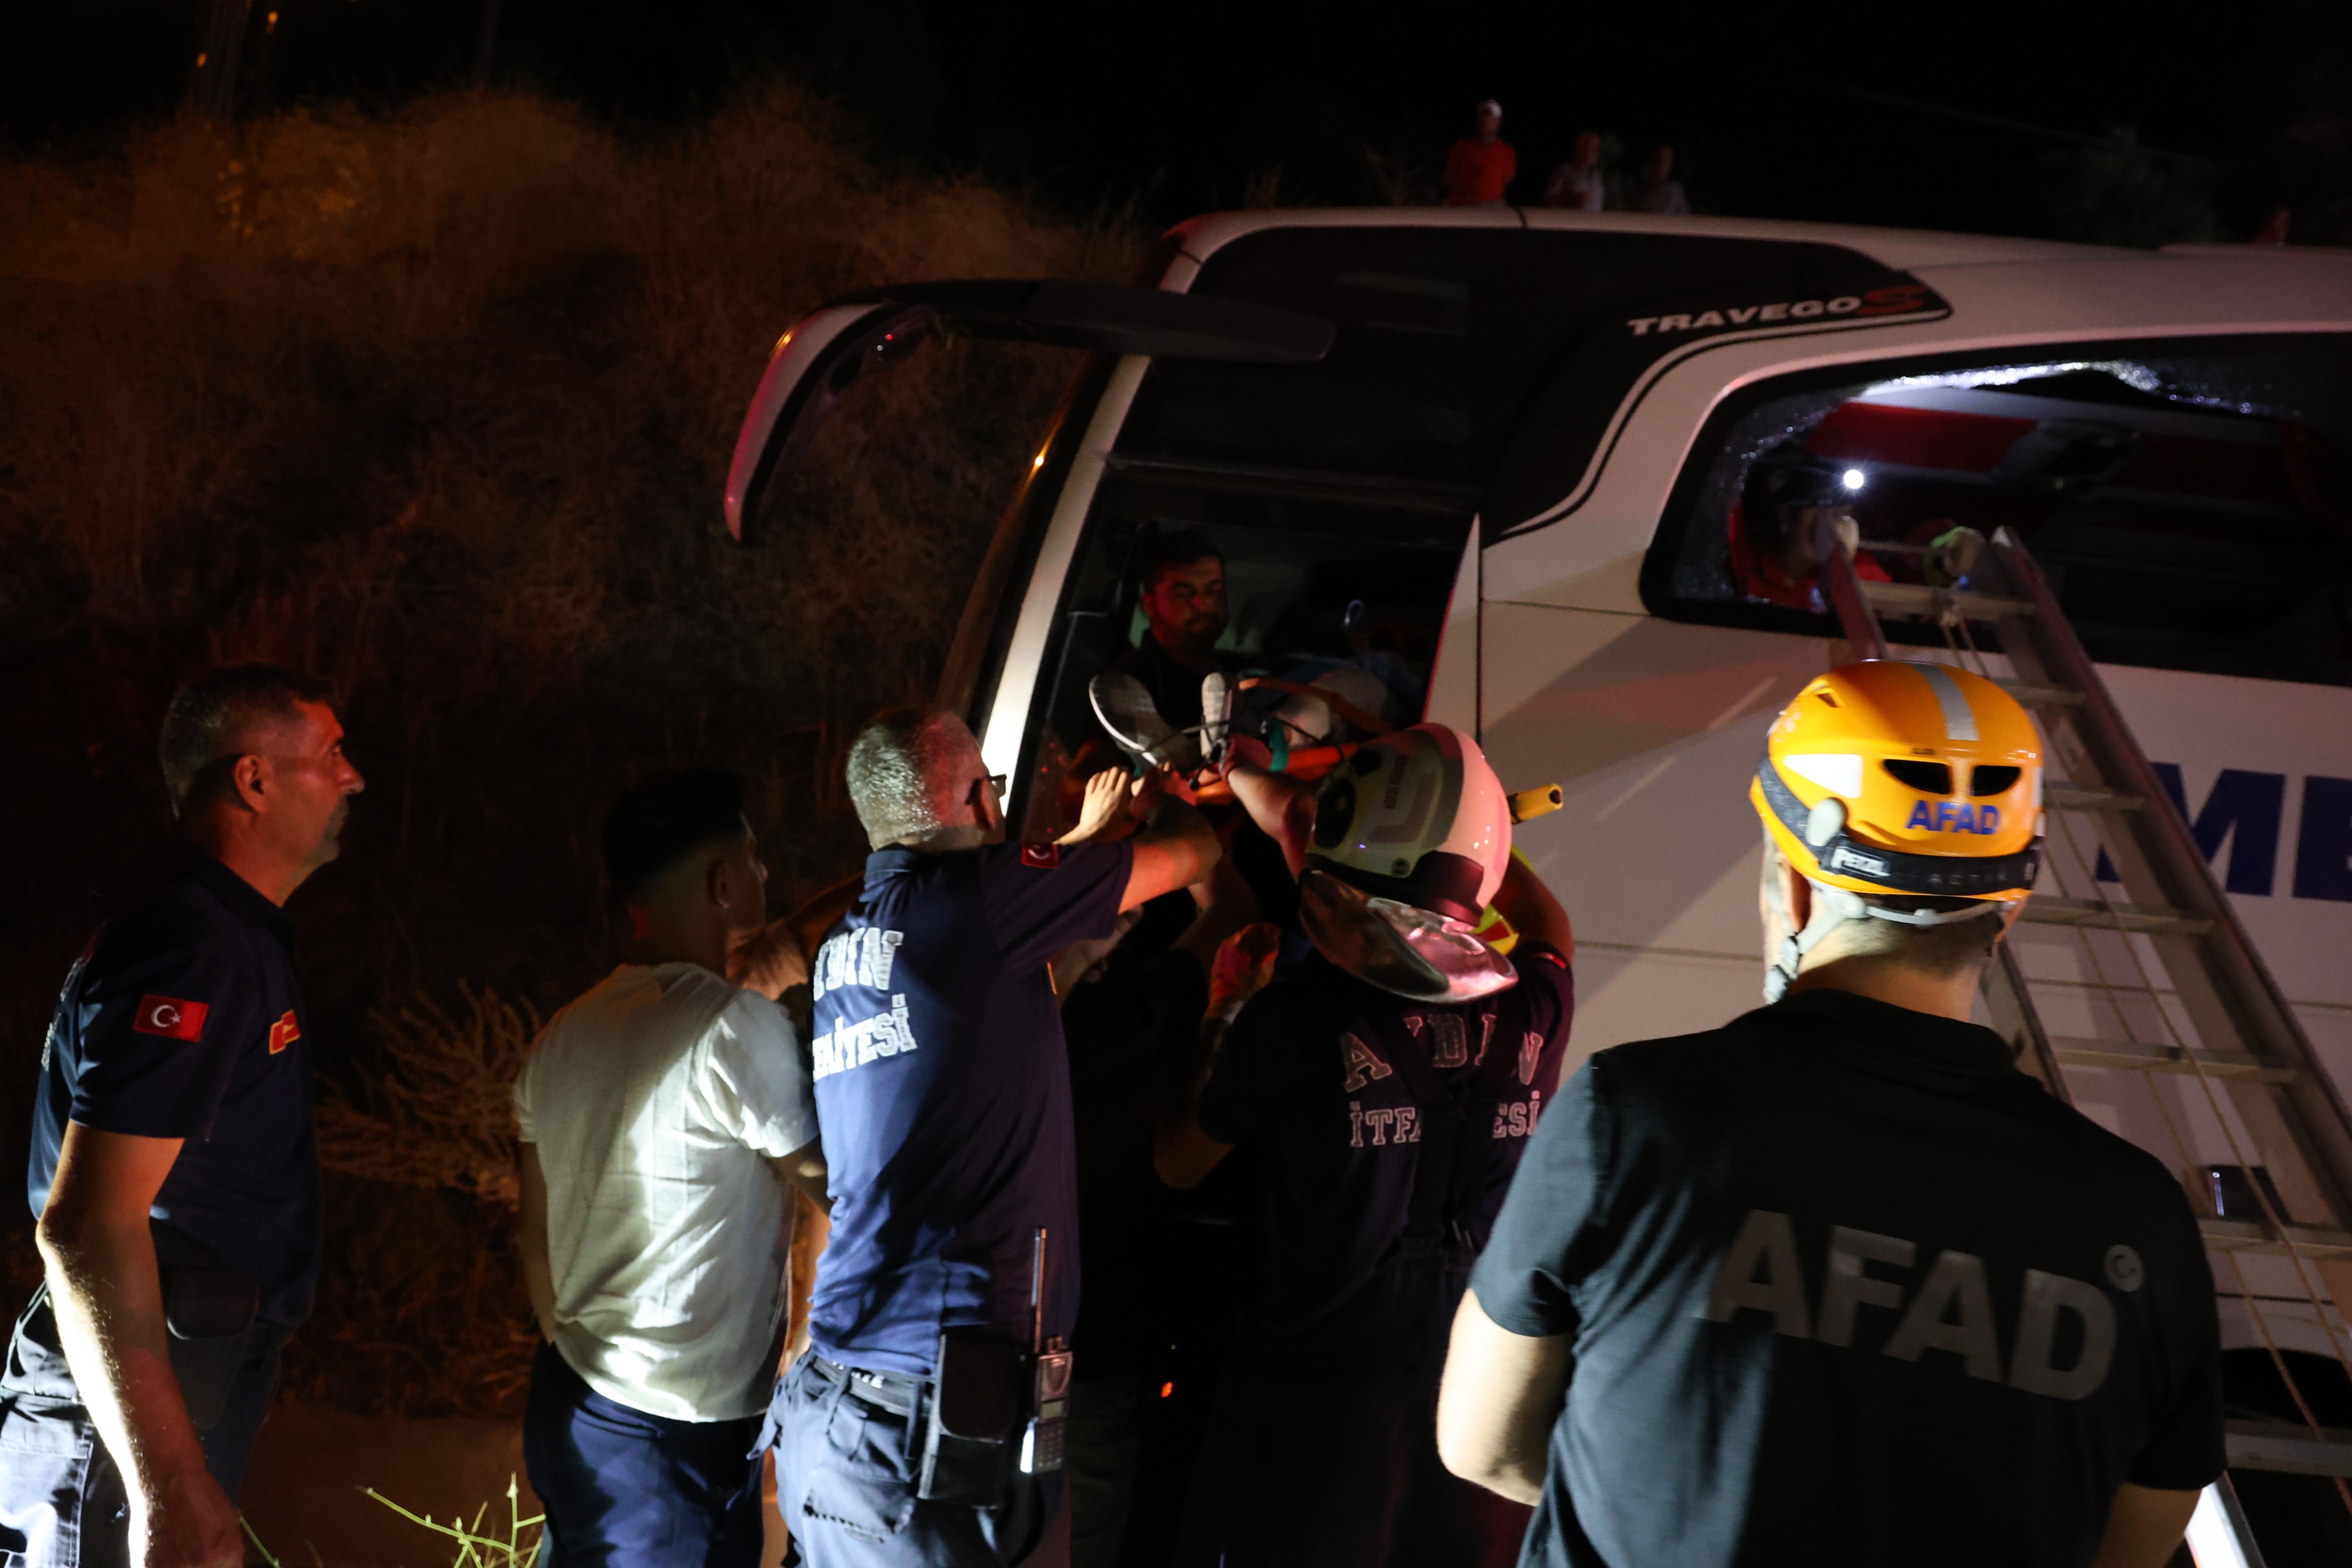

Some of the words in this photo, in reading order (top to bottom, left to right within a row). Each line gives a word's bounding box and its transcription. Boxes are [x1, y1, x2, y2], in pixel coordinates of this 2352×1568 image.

[1628, 296, 1863, 337] TRAVEGO
[1905, 800, 2000, 835] AFAD
[1338, 1012, 1544, 1093] ADIN
[1691, 1208, 2119, 1401] AFAD
